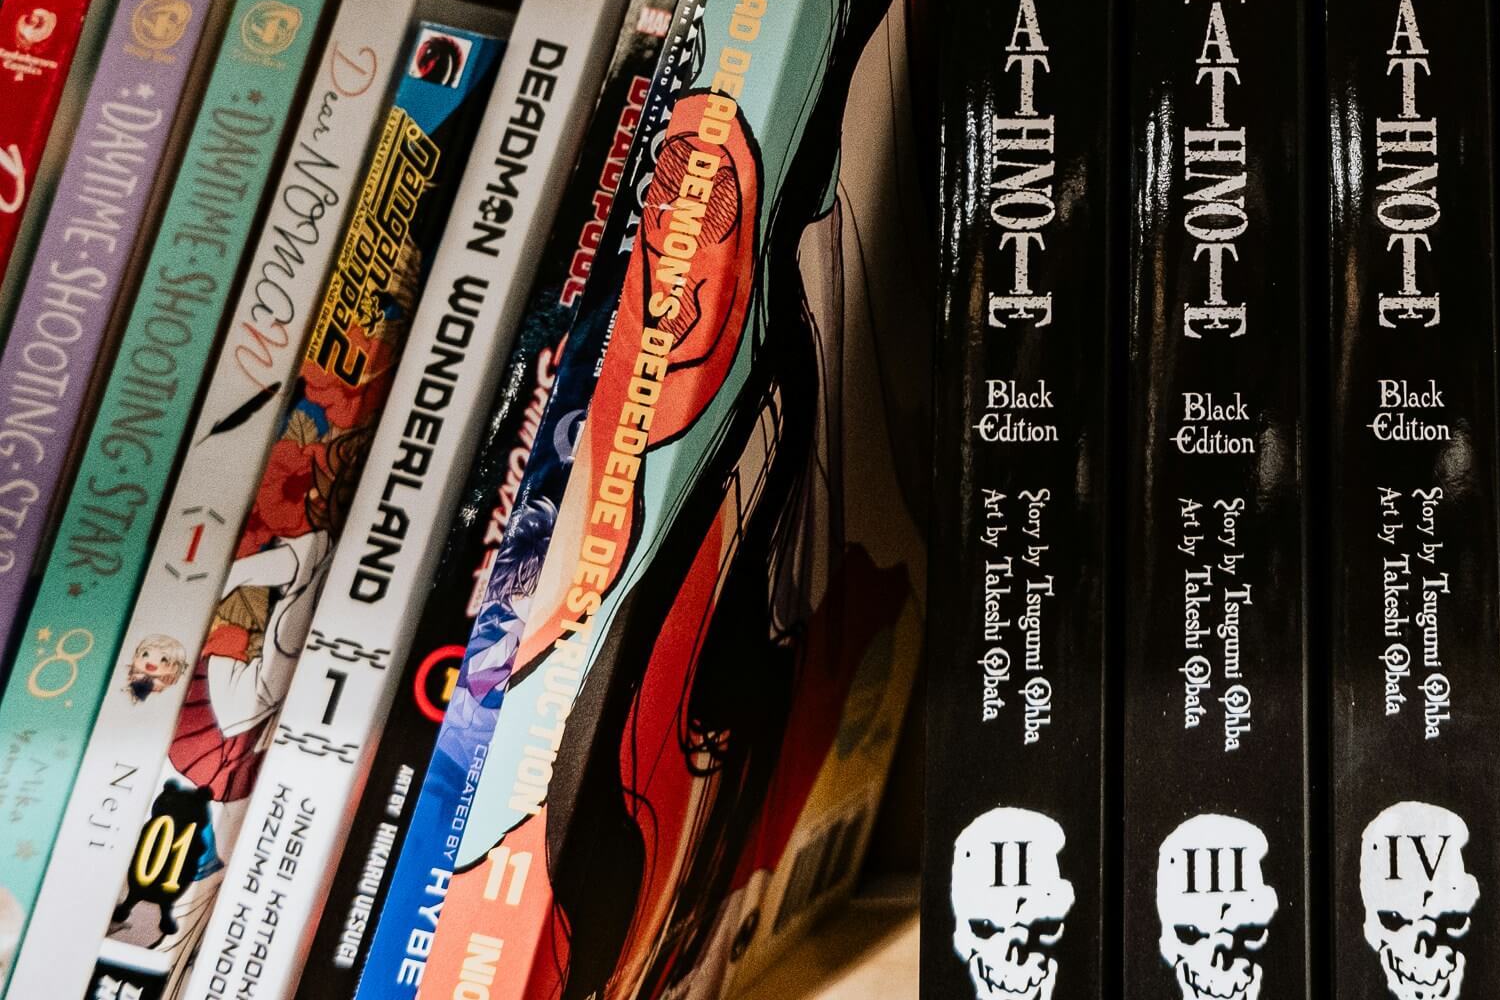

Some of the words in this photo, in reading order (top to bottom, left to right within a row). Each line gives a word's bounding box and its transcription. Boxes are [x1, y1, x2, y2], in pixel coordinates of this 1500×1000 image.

[305, 40, 379, 143] Dear
[660, 36, 682, 87] BLOOD
[698, 45, 752, 146] DEAD
[643, 95, 661, 144] ALTAR
[64, 100, 163, 254] DAYTIME
[173, 105, 275, 260] DAYTIME
[648, 149, 721, 320] DEMON'S
[0, 261, 107, 465] SHOOTING
[100, 265, 218, 466] SHOOTING
[317, 317, 368, 386] 2
[972, 413, 1059, 442] Edition
[985, 379, 1054, 409] Black
[1181, 392, 1249, 421] Black
[1366, 413, 1451, 441] Edition
[1377, 379, 1445, 408] Black
[349, 274, 489, 604] WONDERLAND
[590, 327, 674, 530] DEDEDEDE
[1169, 425, 1255, 454] Edition
[66, 475, 148, 576] STAR
[980, 525, 1007, 548] by
[981, 488, 1007, 518] Art
[1018, 488, 1050, 539] Story
[1178, 498, 1203, 528] Art
[1213, 498, 1245, 547] Story
[1377, 487, 1402, 517] Art
[1378, 523, 1403, 545] by
[1412, 487, 1443, 536] Story
[183, 524, 206, 563] 1
[1022, 545, 1049, 566] by
[1178, 536, 1204, 556] by
[1218, 554, 1244, 575] by
[1417, 543, 1443, 564] by
[985, 556, 1014, 641] Takeshi
[1018, 575, 1055, 671] Tsugumi
[1185, 565, 1213, 649] Takeshi
[1383, 554, 1411, 638] Takeshi
[1416, 573, 1450, 667] Tsugumi
[27, 629, 94, 698] 8
[1217, 583, 1253, 679] Tsugumi
[321, 669, 348, 725] 1
[508, 535, 618, 816] DESTRUCTION
[977, 647, 1010, 722] Obata
[1178, 655, 1211, 729] Obata
[1378, 643, 1411, 716] Obata
[1418, 673, 1450, 740] Ohba
[1018, 677, 1051, 745] Ohba
[1218, 684, 1251, 752] Ohba
[88, 761, 138, 850] Neji
[452, 743, 491, 831] CREATED
[136, 815, 197, 890] 01
[243, 783, 294, 894] KAZUMA
[277, 797, 316, 881] JINSEI
[358, 822, 399, 899] HIKARU
[990, 841, 1032, 887] II
[1182, 847, 1247, 893] III
[1385, 835, 1451, 881] IV
[484, 846, 532, 906] 11
[333, 896, 375, 968] UESUGI
[397, 867, 453, 986] HYBE
